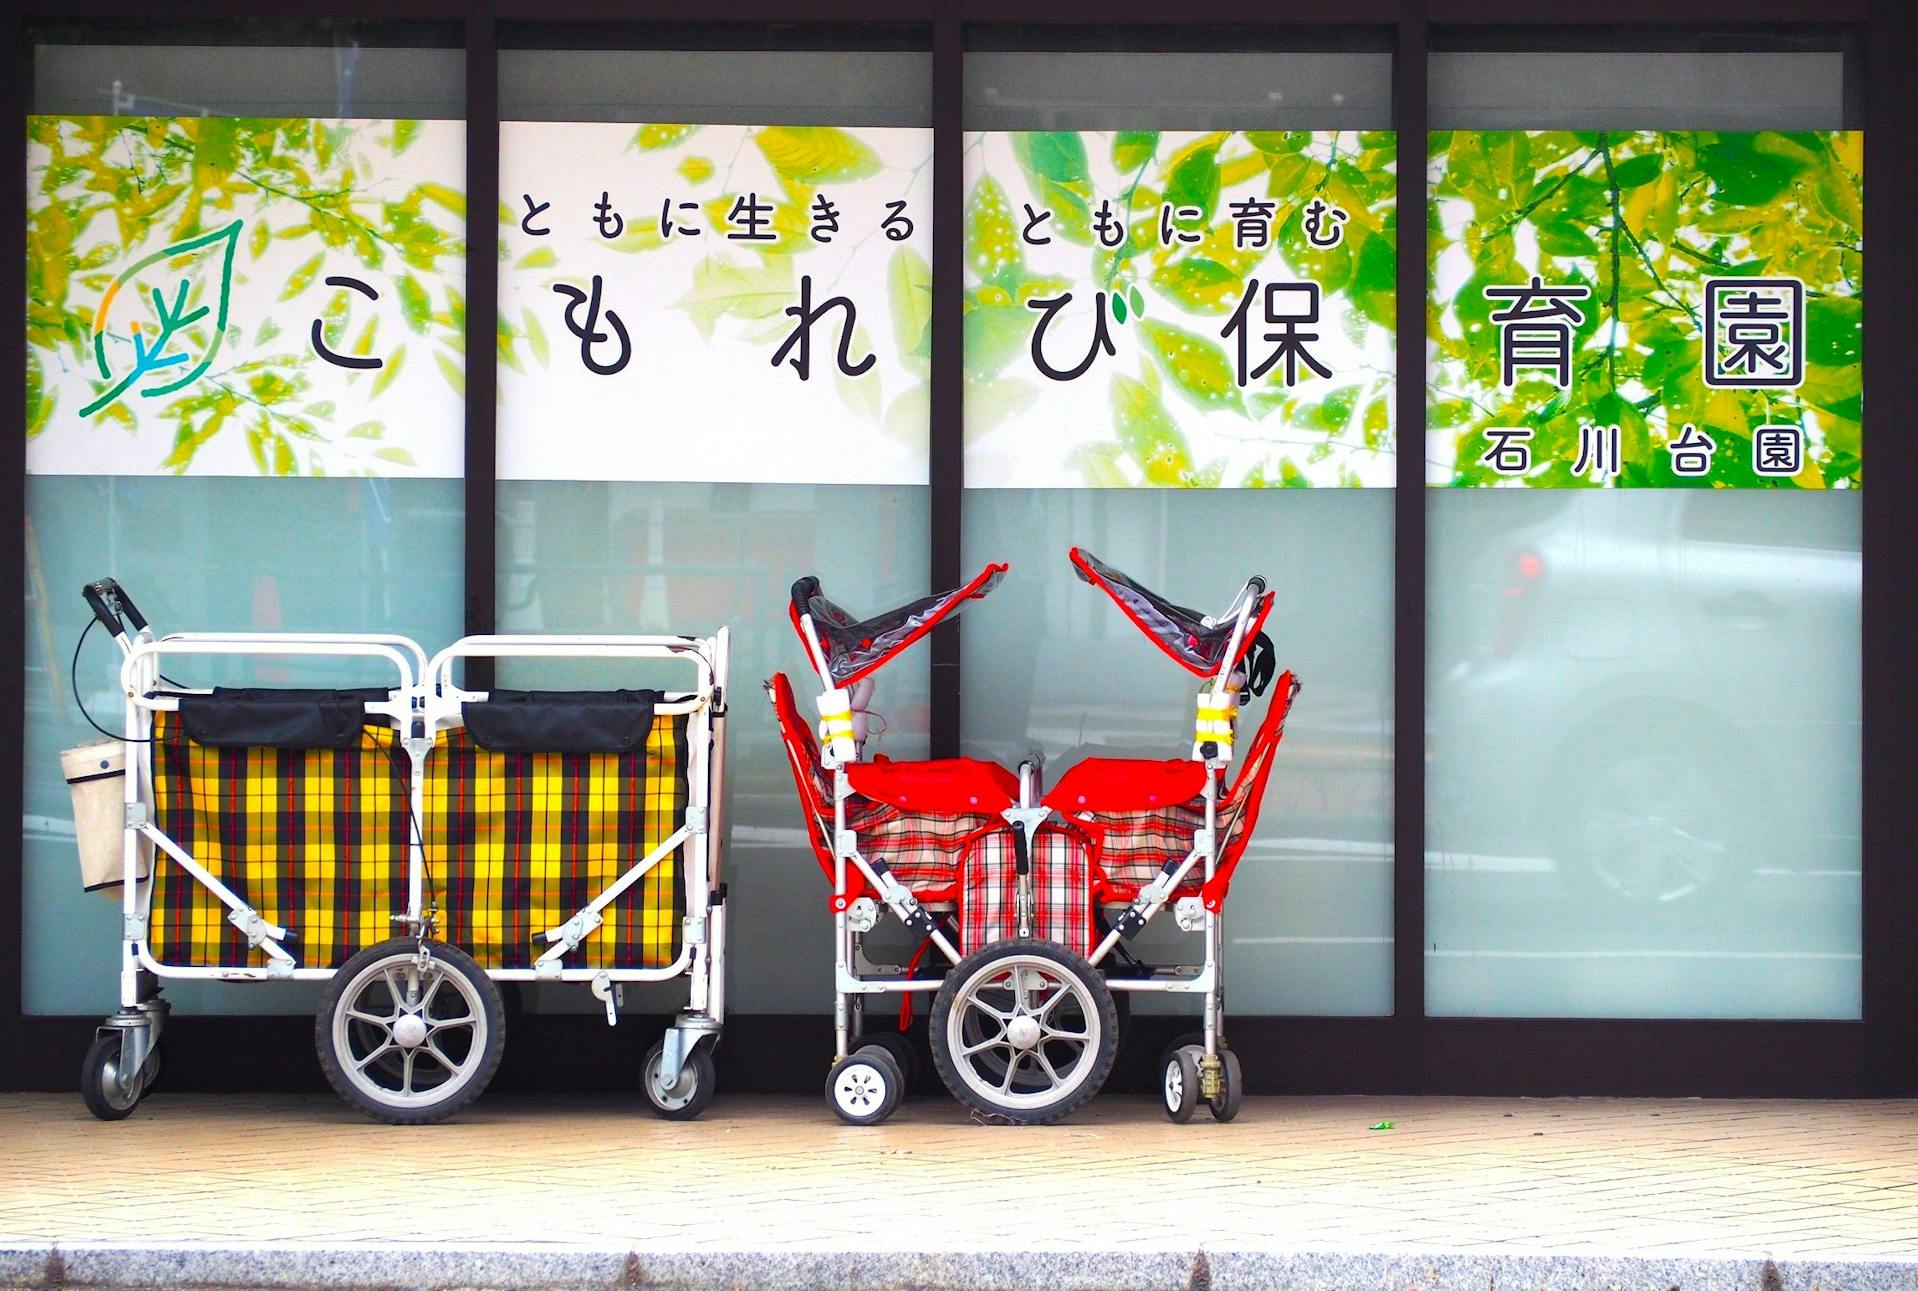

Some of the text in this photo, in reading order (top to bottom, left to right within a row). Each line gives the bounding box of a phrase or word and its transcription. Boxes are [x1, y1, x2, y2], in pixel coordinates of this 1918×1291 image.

[521, 191, 1348, 248] ともに生きる ともに育む
[312, 275, 1804, 388] こもれび保育園
[1484, 427, 1800, 473] 石川台園
